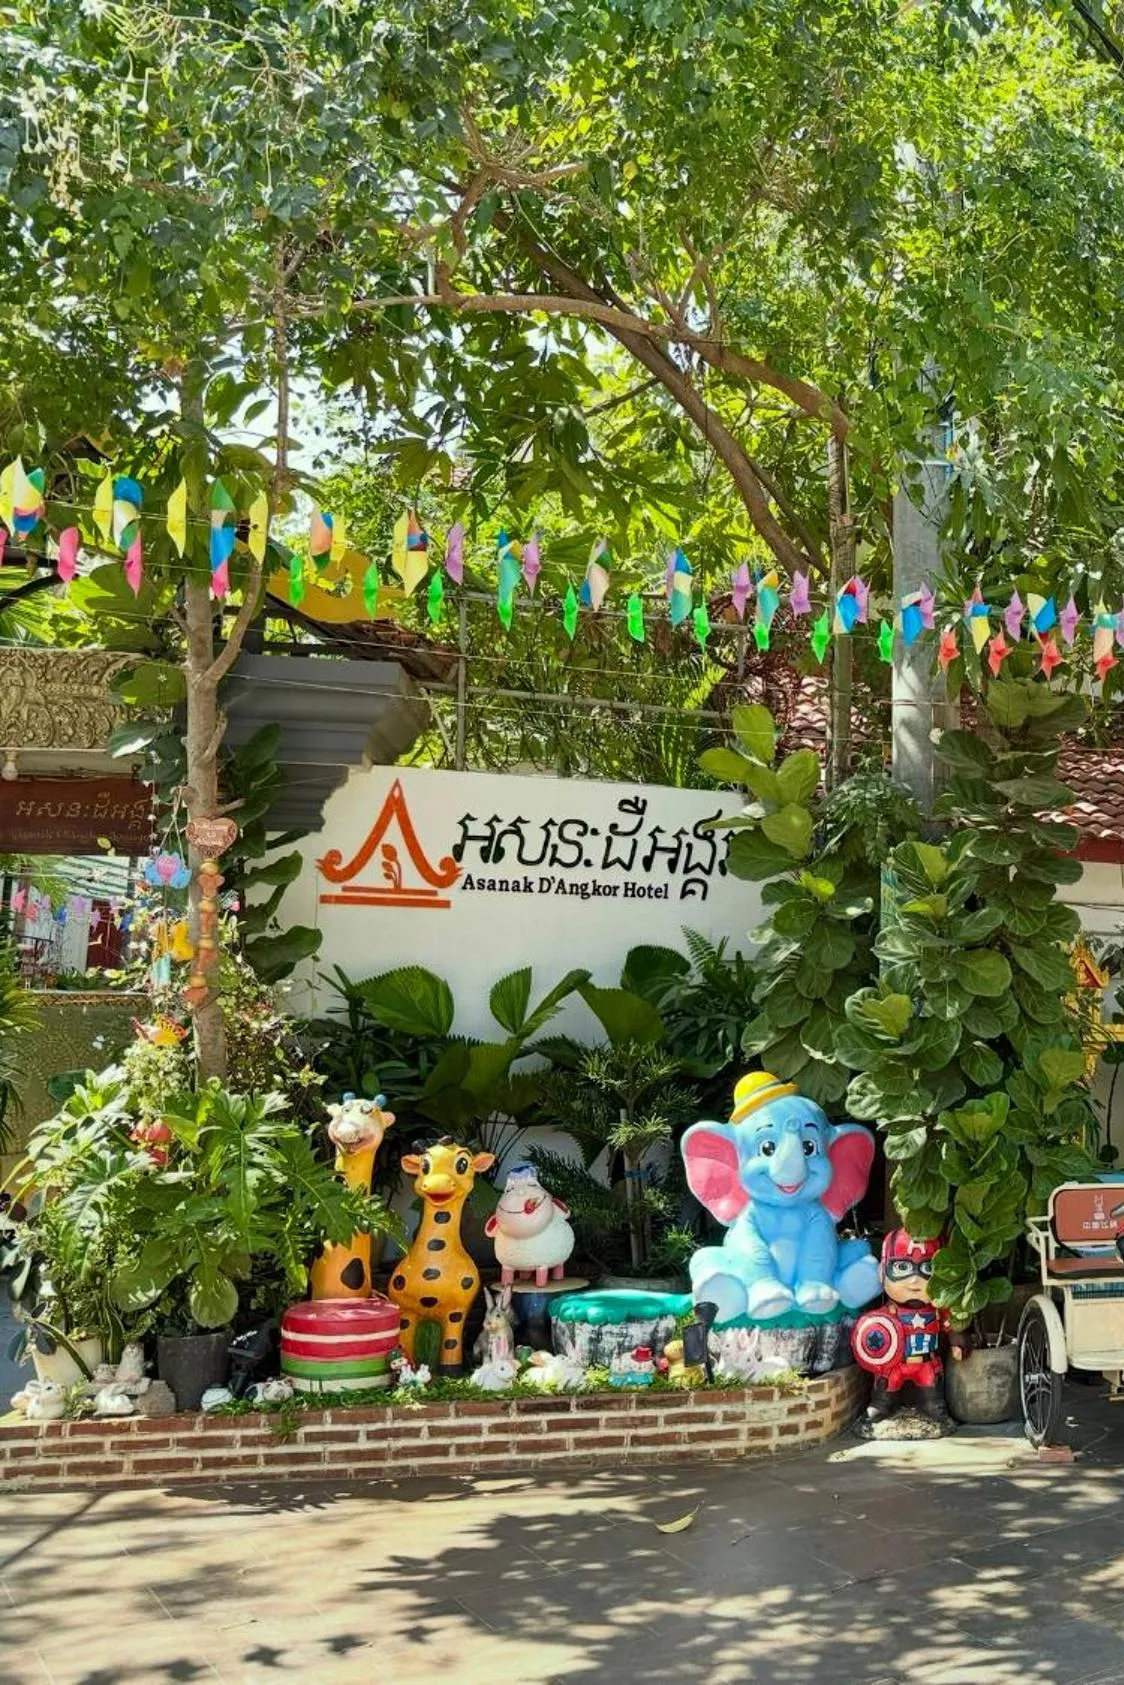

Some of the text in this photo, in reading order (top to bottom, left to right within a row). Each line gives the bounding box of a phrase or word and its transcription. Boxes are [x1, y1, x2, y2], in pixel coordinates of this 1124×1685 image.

[461, 874, 669, 900] Asanak D'Angkor Hotel
